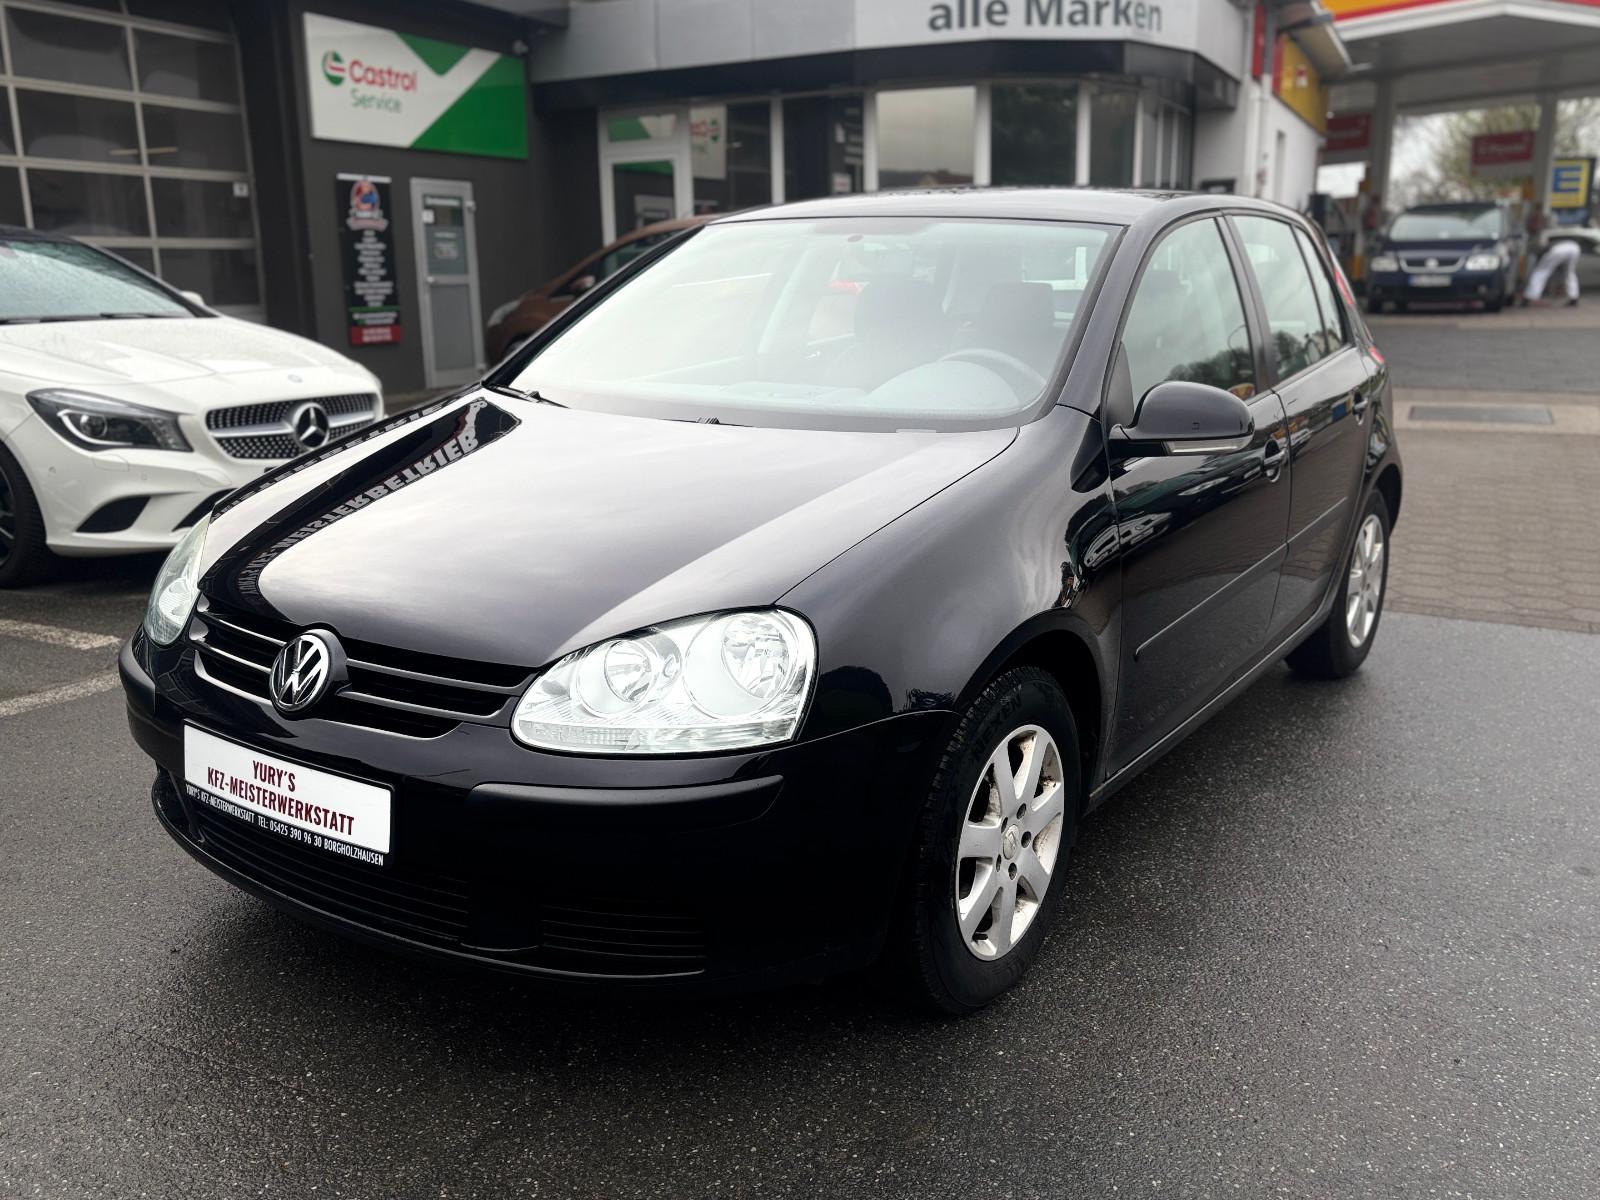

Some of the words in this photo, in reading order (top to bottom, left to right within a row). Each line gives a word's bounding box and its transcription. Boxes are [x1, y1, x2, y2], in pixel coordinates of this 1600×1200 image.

[928, 0, 1010, 31] alle
[1025, 0, 1162, 32] Marken
[349, 58, 418, 94] Castrol
[350, 87, 402, 114] Service
[253, 760, 296, 792] YURY'S
[207, 766, 355, 836] KFZ-MEISTERWERKSTATT
[201, 791, 255, 823] KFZ-MEISTERWERKSTATT
[269, 820, 288, 836] 05425
[289, 827, 302, 841] 390
[303, 832, 312, 844] 96
[313, 835, 322, 848] 30
[323, 838, 384, 866] BORGHOLZHAUSEN
